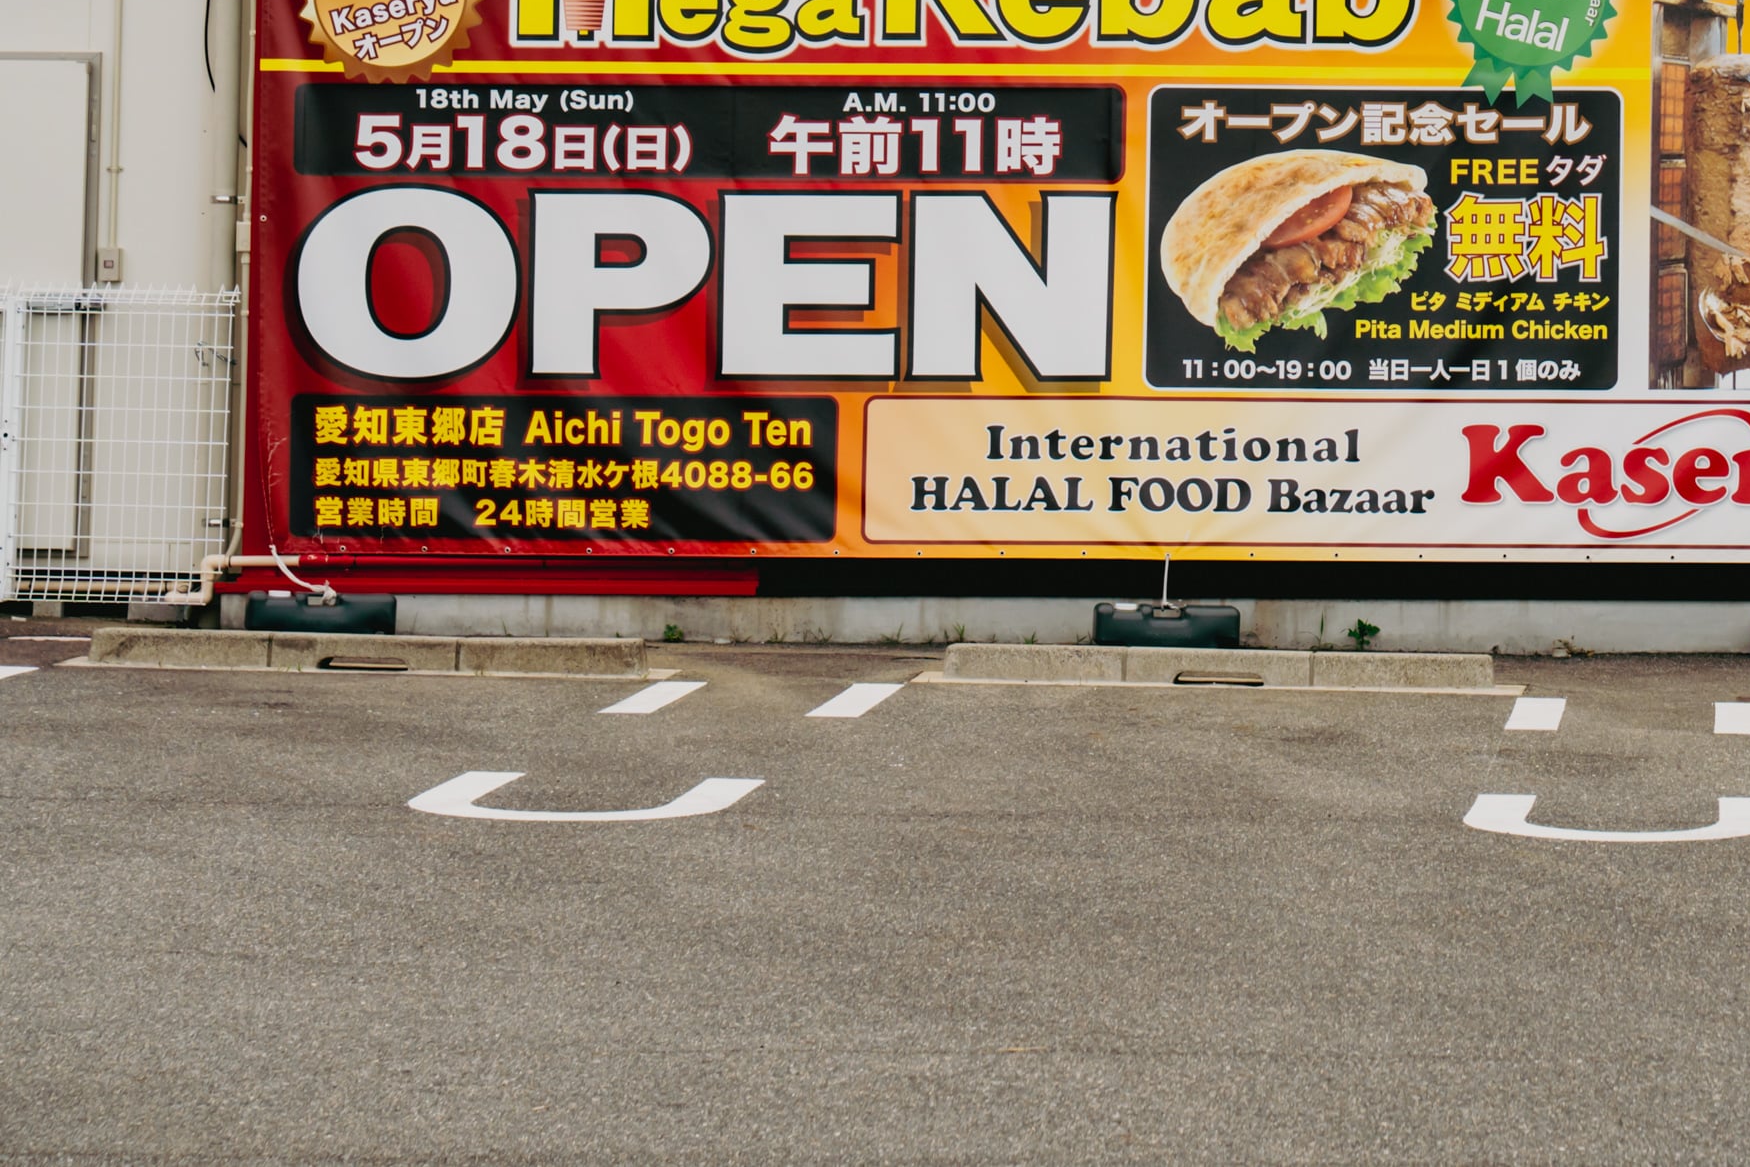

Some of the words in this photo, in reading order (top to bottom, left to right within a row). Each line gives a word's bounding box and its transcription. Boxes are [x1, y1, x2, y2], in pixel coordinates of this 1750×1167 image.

[353, 15, 449, 61] オープン
[417, 89, 479, 109] 18th
[490, 90, 548, 113] May
[560, 89, 634, 112] (Sun)
[843, 93, 906, 113] A.M.
[919, 93, 996, 113] 11:00
[1178, 100, 1593, 145] オープン記念セール
[354, 114, 692, 172] 5月18日(日)
[768, 114, 1062, 175] 午前11時
[1450, 158, 1539, 185] FREE
[1545, 155, 1607, 187] タダ
[1446, 192, 1607, 282] 無料
[294, 183, 1117, 381] OPEN
[1410, 291, 1447, 312] ピタ
[1456, 291, 1546, 312] ミディアム
[1553, 291, 1610, 312] チキン
[1355, 319, 1402, 340] Pita
[1409, 320, 1504, 340] Medium
[1512, 320, 1608, 340] Chicken
[314, 406, 505, 447] 愛知東郷店
[525, 410, 621, 447] Aichi
[634, 411, 731, 453] Togo
[742, 412, 812, 447] Ten
[985, 424, 1361, 463] International
[314, 498, 440, 528] 営業時間
[474, 498, 650, 530] 24時間営業
[910, 475, 1094, 512] HALAL
[1107, 476, 1252, 513] FOOD
[1267, 477, 1435, 515] Bazaar
